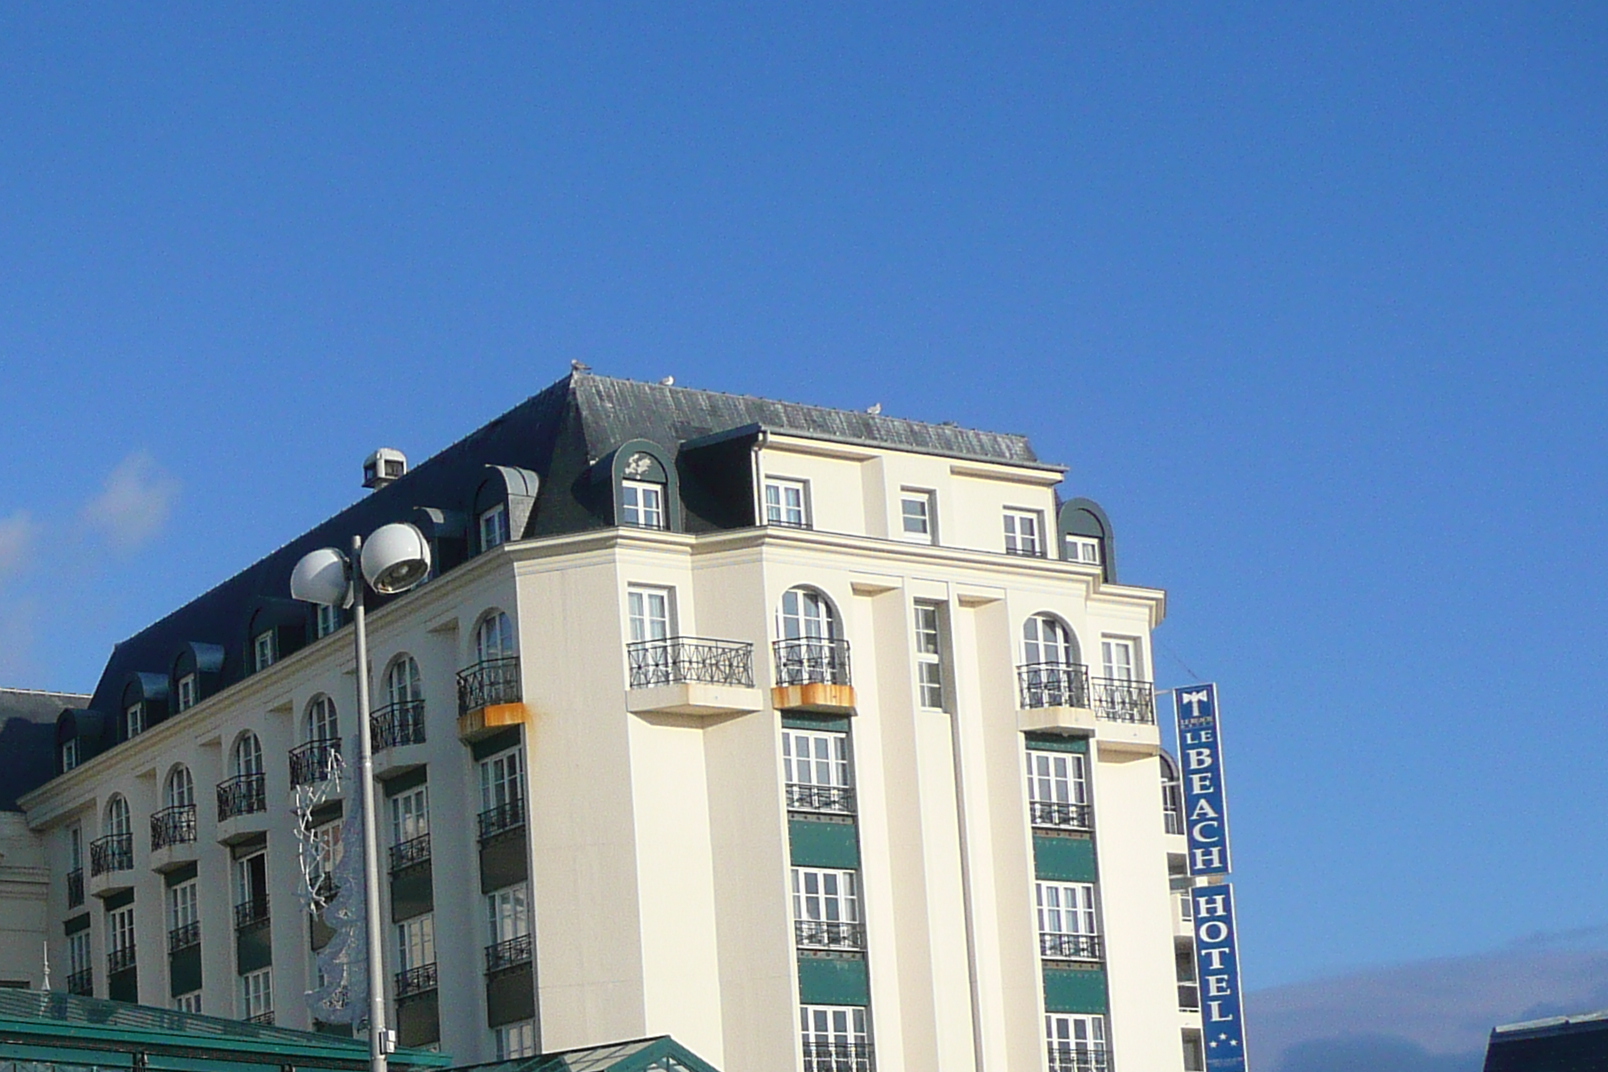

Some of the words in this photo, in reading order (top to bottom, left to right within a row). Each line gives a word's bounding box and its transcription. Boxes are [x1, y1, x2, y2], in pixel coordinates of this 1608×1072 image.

[1185, 730, 1213, 744] LE
[1186, 748, 1222, 869] BEACH
[1196, 895, 1233, 1022] HOTEL
